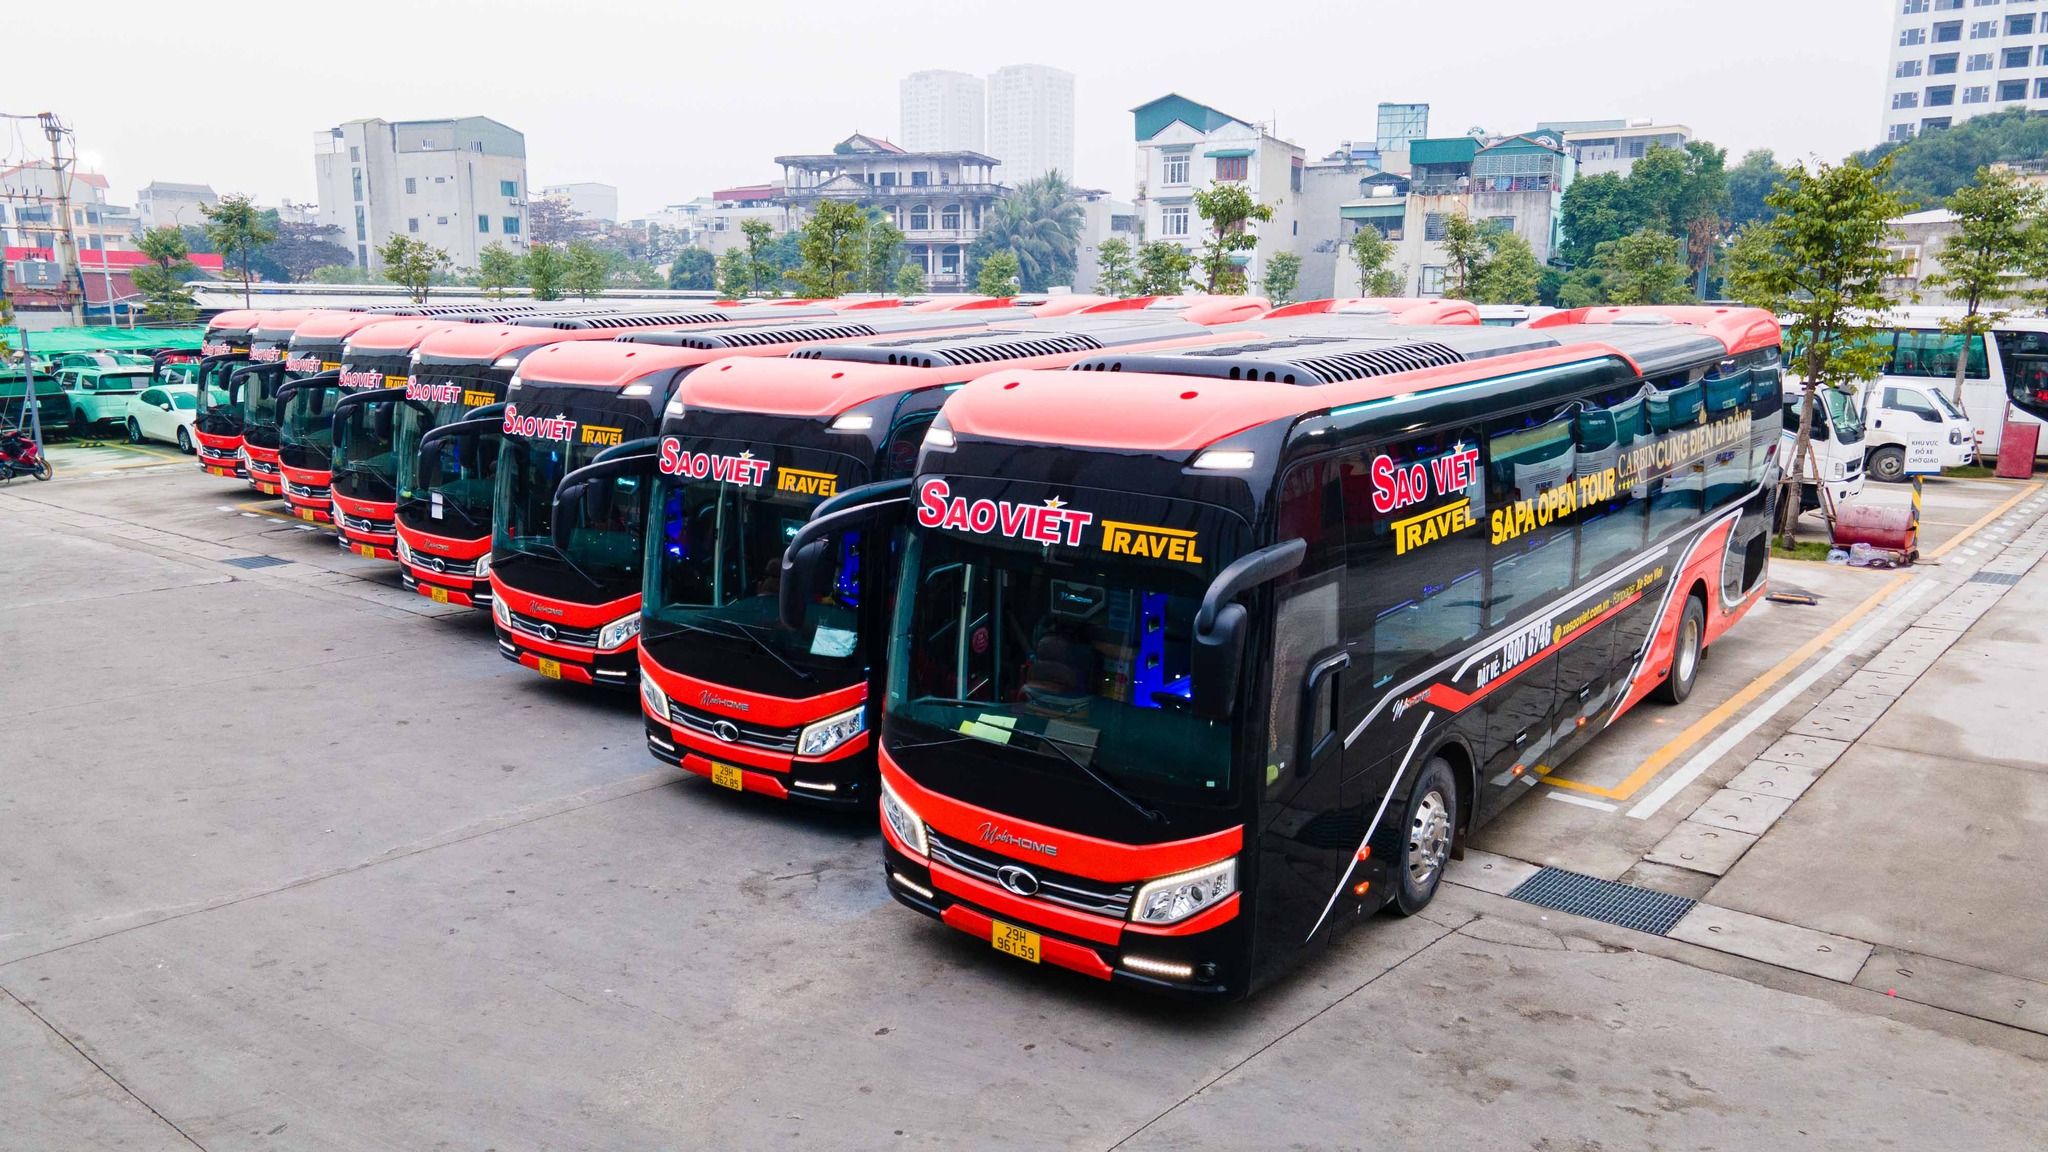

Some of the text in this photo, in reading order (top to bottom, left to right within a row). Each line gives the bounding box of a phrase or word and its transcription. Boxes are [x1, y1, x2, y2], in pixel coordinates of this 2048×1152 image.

[339, 365, 359, 387] SAO
[406, 375, 431, 401] SAO
[503, 405, 537, 437] SAO
[1618, 443, 1656, 479] CARBIN
[1656, 433, 1688, 470] CUNG
[1716, 418, 1726, 445] DI
[659, 438, 710, 479] SAO
[778, 467, 840, 497] TRAVEL
[1372, 455, 1427, 513] SAO
[918, 479, 998, 534] SAO
[1101, 520, 1203, 563] TRAVEL
[1391, 497, 1476, 555] TRAVEL
[1491, 467, 1616, 545] SAPA OPEN TOUR
[1502, 636, 1526, 673] 1900
[1528, 619, 1551, 657] 6746
[720, 765, 734, 778] 29H
[997, 937, 1035, 960] 961.59
[1005, 926, 1027, 944] 29H
